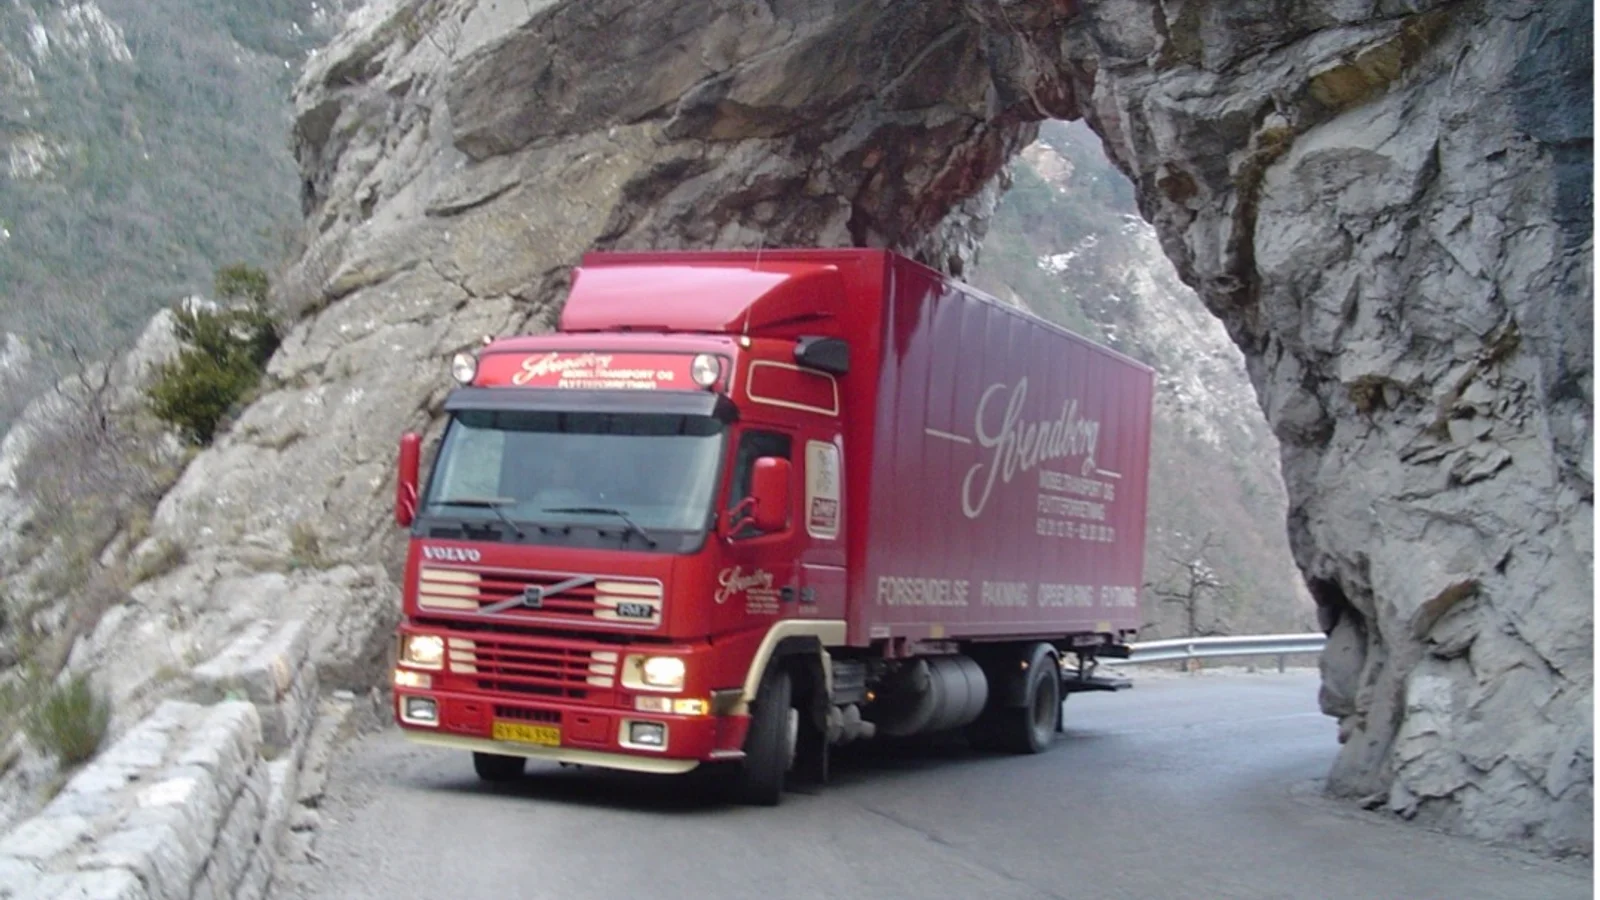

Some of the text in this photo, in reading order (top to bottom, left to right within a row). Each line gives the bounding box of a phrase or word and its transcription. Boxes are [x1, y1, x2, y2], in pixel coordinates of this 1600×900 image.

[657, 370, 675, 382] OG
[962, 376, 1100, 519] Svendborg
[1103, 483, 1116, 502] OG
[422, 545, 481, 562] VOLVO
[876, 576, 970, 607] FORSENDELSE
[619, 603, 651, 618] FM7
